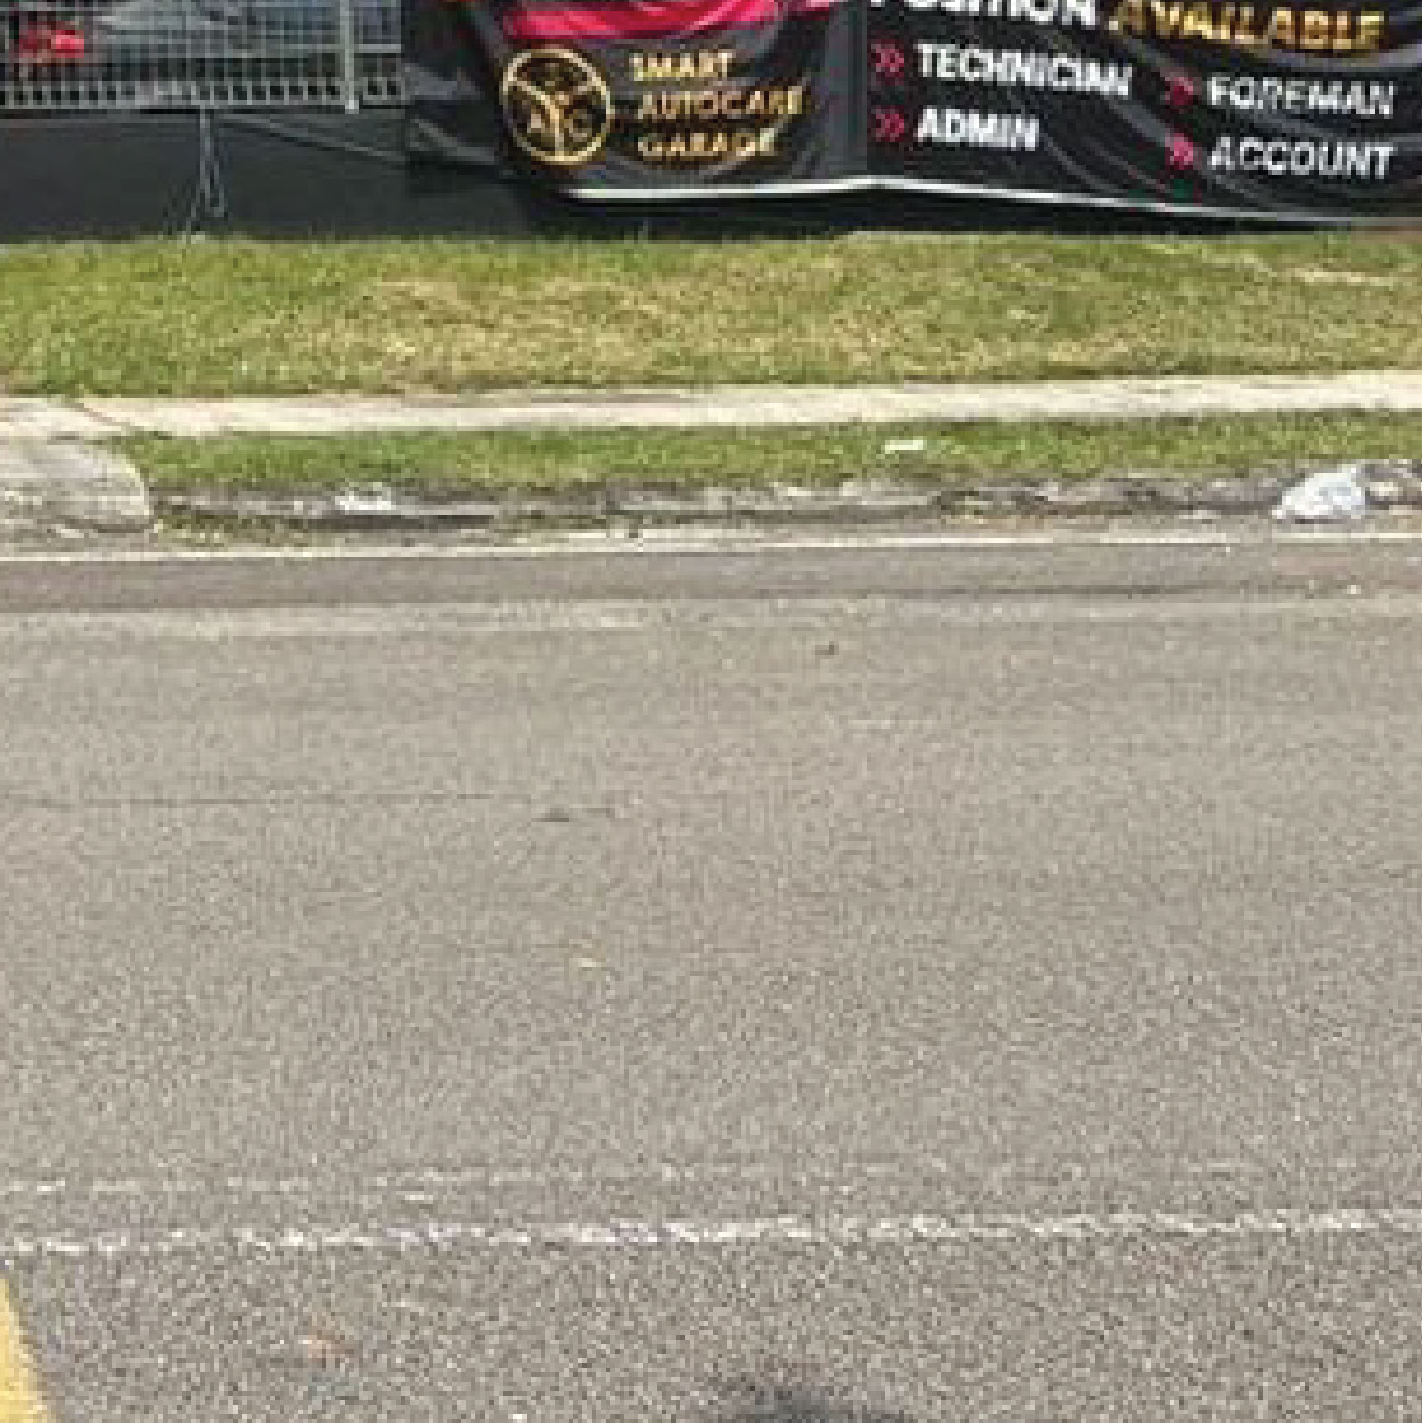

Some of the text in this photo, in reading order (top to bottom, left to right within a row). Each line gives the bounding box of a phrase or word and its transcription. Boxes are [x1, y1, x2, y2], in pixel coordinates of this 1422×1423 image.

[915, 42, 1133, 97] TECHNICIAN
[1208, 73, 1396, 118] FOREMAN
[916, 107, 1040, 152] ADMIN
[1210, 135, 1396, 179] ACCOUNT
